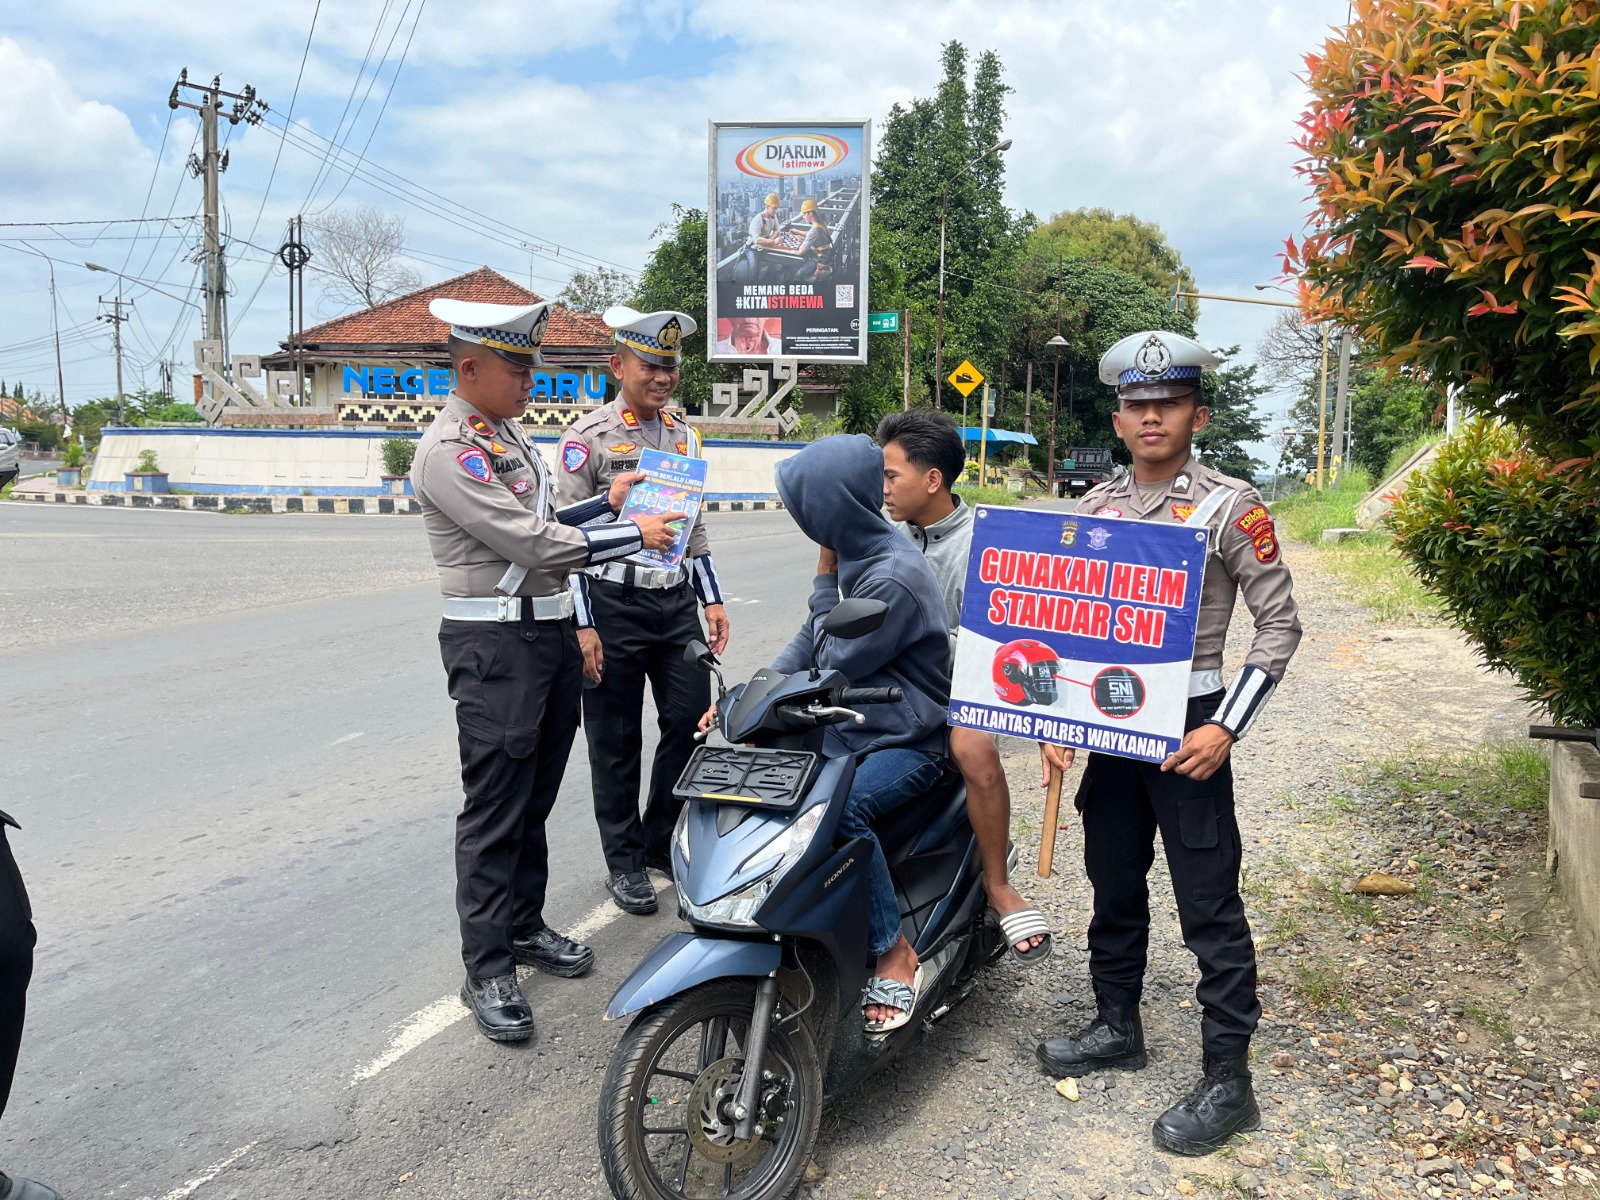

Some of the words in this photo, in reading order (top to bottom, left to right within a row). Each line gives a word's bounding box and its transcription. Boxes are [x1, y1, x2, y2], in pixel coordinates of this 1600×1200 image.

[766, 144, 826, 161] DJARUM
[781, 160, 825, 168] Istimewa
[743, 285, 786, 296] MEMANG
[789, 284, 814, 295] BEDA
[735, 295, 824, 309] #KITAISTIMEWA
[343, 366, 457, 396] NEGE
[530, 371, 607, 399] ARU
[659, 472, 684, 482] BERLALU
[1240, 508, 1265, 527] POLRES
[979, 547, 1109, 598] GUNAKAN
[1109, 562, 1188, 609] HELM
[987, 587, 1112, 640] STANDAR
[1113, 605, 1167, 648] SNI
[1108, 681, 1134, 696] SNI
[959, 705, 1032, 735] SATLANTAS
[1034, 718, 1085, 745] POLRES
[1087, 727, 1167, 759] WAYKANAN
[824, 857, 855, 888] HONDA
